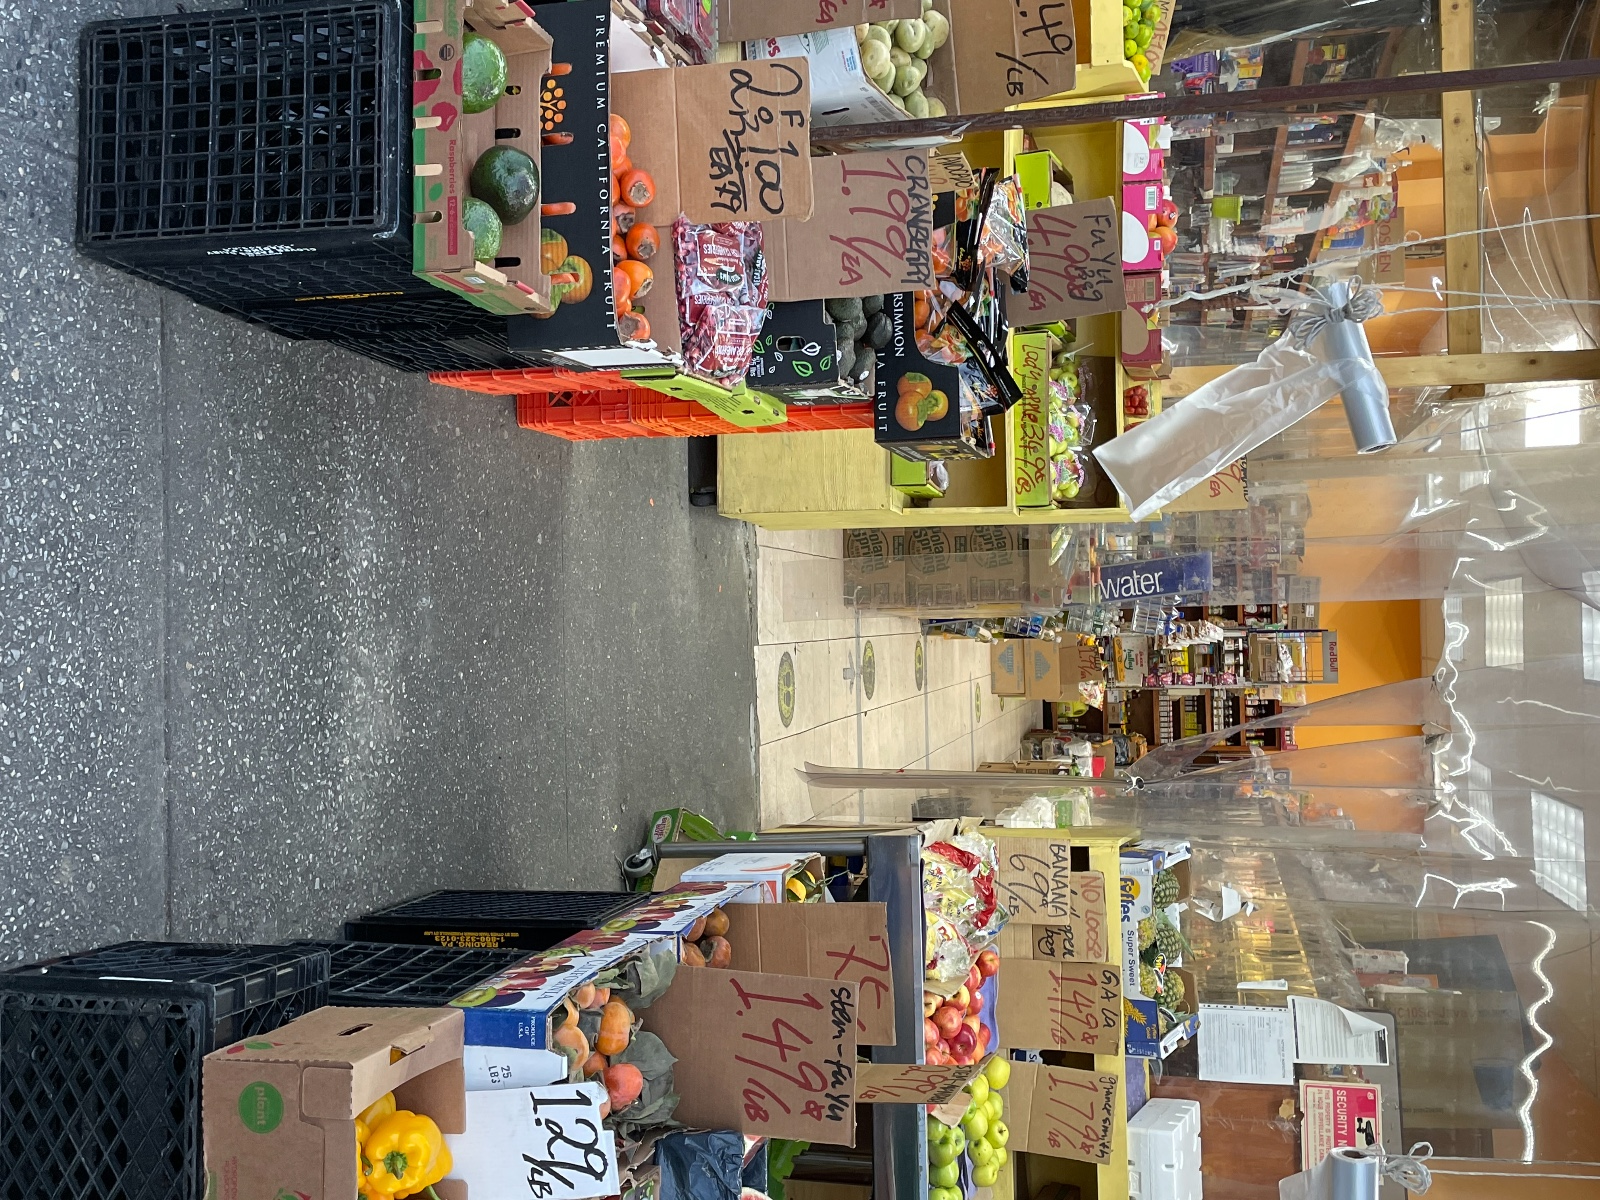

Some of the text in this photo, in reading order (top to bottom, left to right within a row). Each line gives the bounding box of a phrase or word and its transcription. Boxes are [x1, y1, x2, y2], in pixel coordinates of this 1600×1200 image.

[729, 64, 803, 110] 2
[448, 139, 457, 194] Raspberries
[595, 14, 617, 330] PREMIUM CALIFORNIA FRUIT
[935, 156, 973, 188] AVOCADO
[900, 155, 932, 288] CRANBERRY
[893, 293, 905, 358] RSIMMON
[1013, 344, 1046, 381] Lady
[877, 381, 888, 432] FRUIT
[851, 529, 875, 574] Spring
[868, 528, 889, 571] Poland
[912, 528, 936, 575] Spring
[927, 526, 950, 572] Poland
[975, 525, 999, 569] Spring
[993, 525, 1013, 567] Poland
[1098, 570, 1163, 600] water
[1124, 649, 1135, 671] halley
[1047, 844, 1069, 918] BANANA
[1081, 875, 1102, 903] NO
[456, 940, 498, 948] READING,
[1126, 930, 1136, 987] Super Sweet
[536, 959, 606, 1001] CALIFORNIA
[524, 1026, 530, 1035] OF
[488, 1066, 500, 1084] LBS
[500, 1066, 512, 1078] 25
[254, 1086, 267, 1126] plant
[1336, 1090, 1348, 1135] SECURITY
